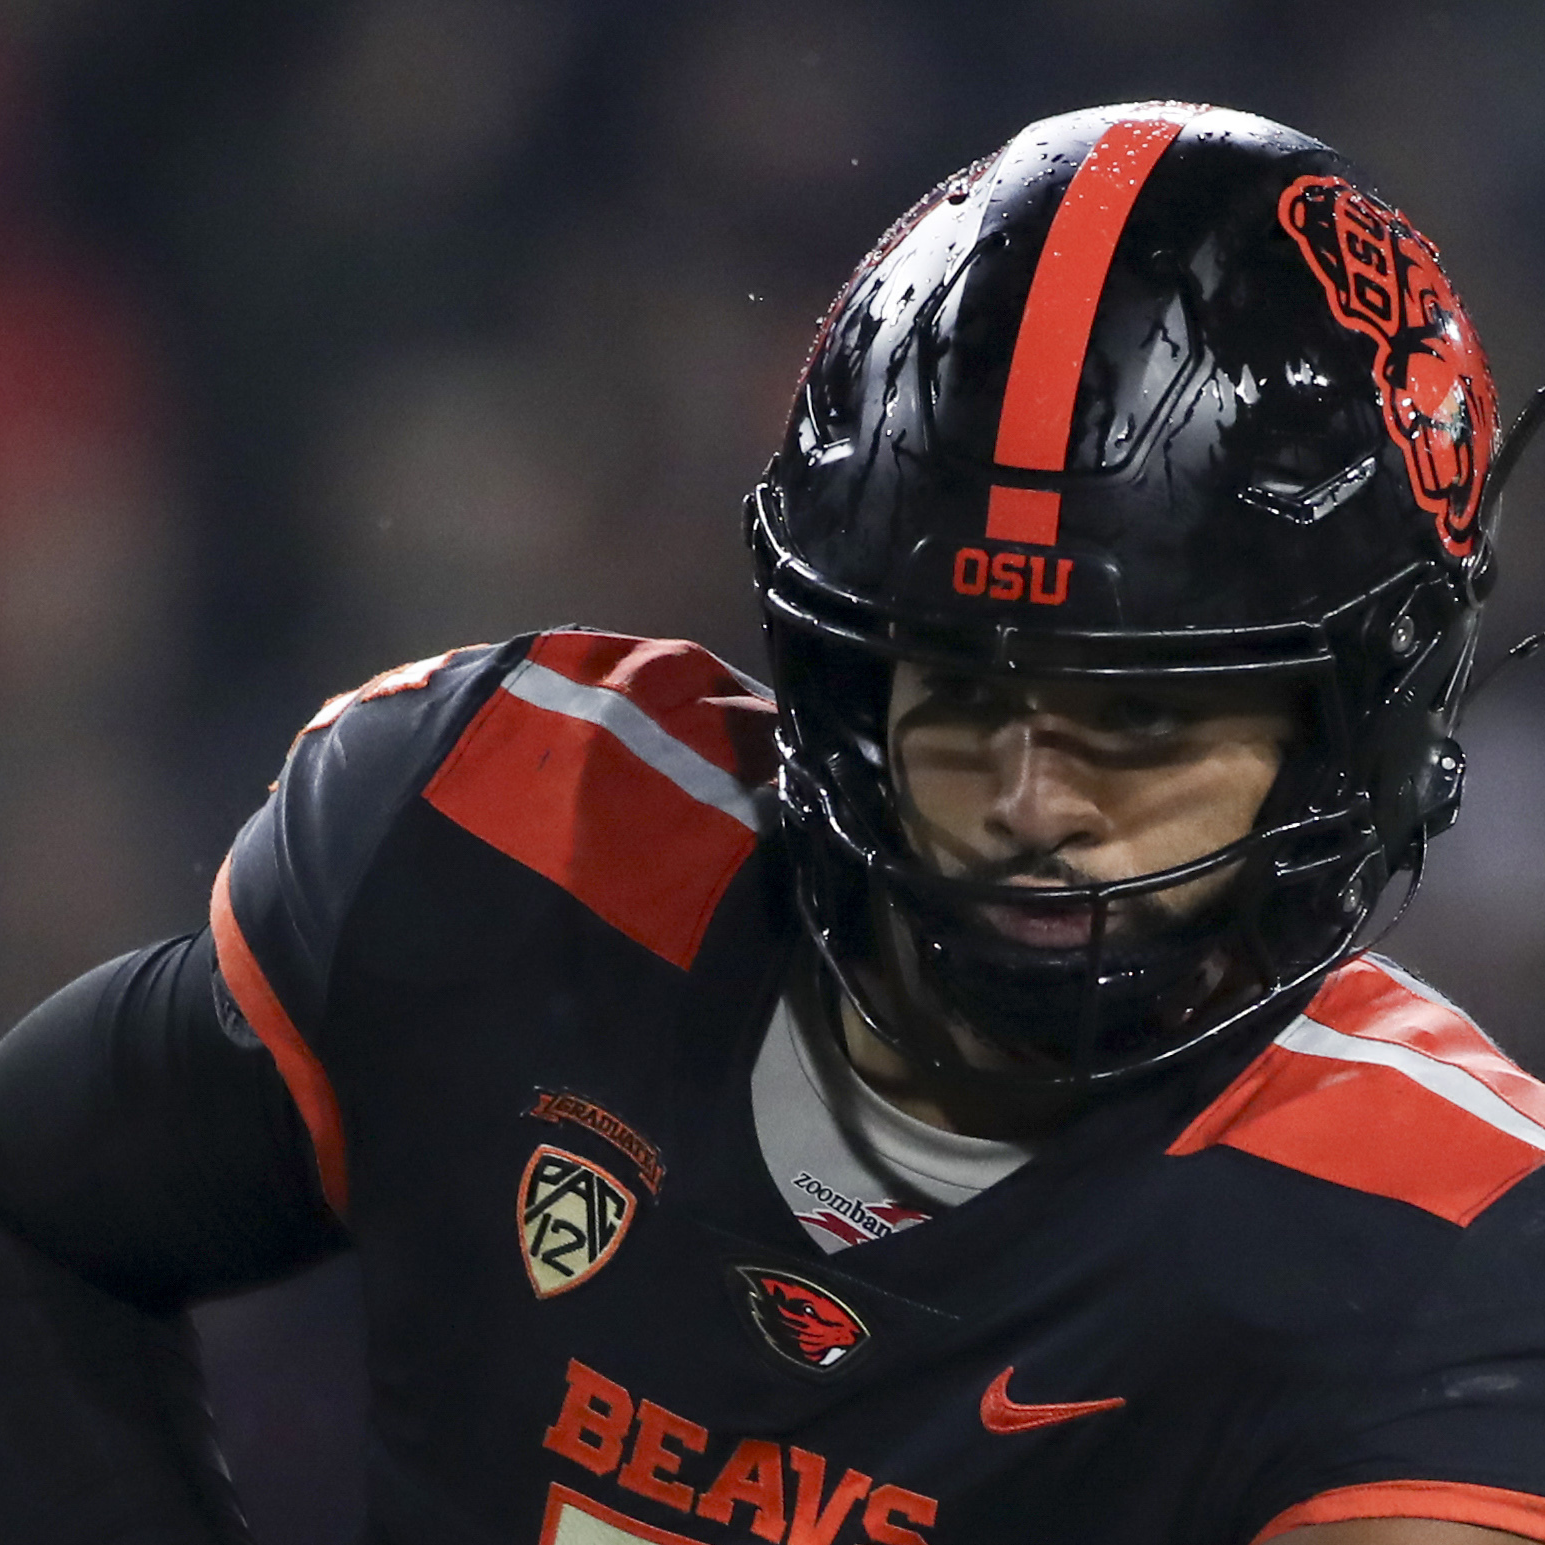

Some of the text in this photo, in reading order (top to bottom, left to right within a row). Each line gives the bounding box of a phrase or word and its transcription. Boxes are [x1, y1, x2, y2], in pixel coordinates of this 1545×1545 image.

[1342, 197, 1393, 322] OSU
[952, 546, 1074, 606] OSU
[524, 1154, 627, 1264] PAC
[529, 1212, 587, 1278] 12
